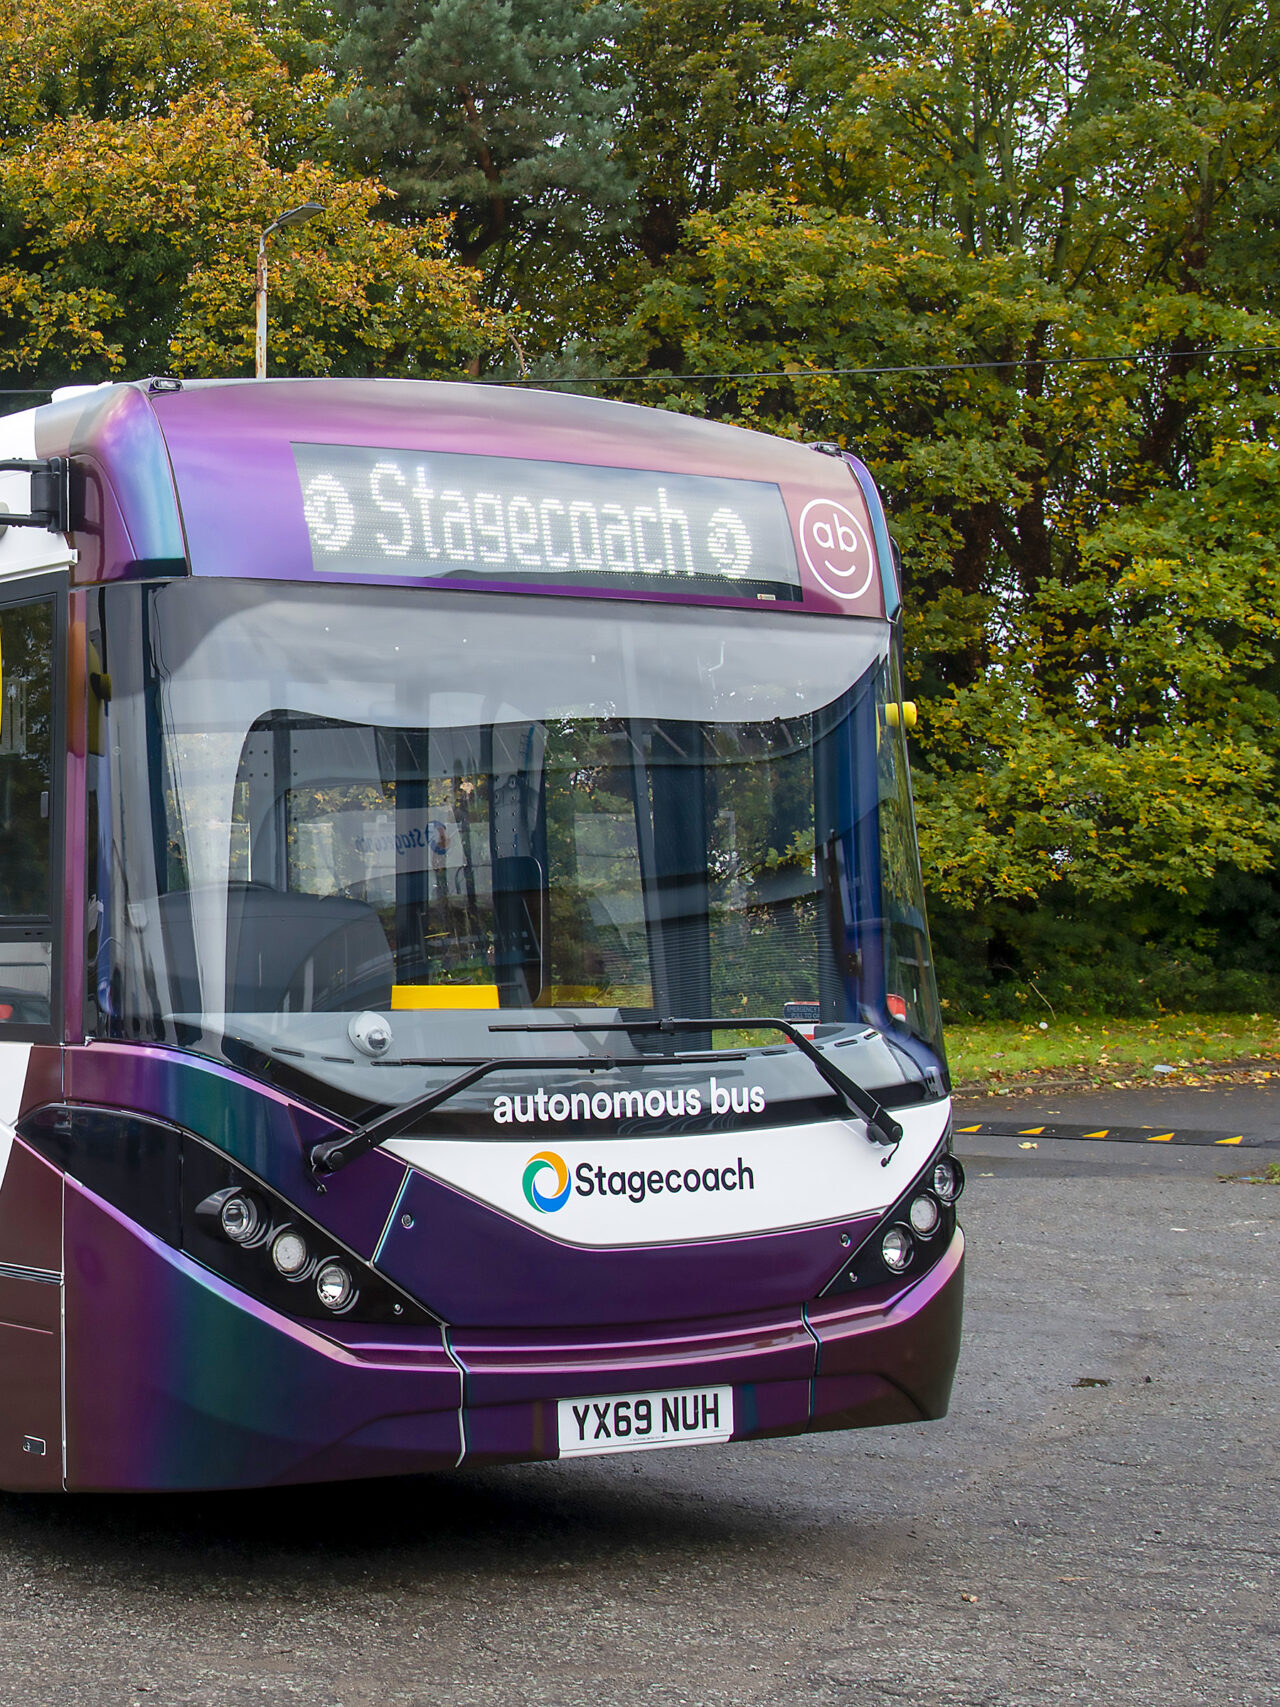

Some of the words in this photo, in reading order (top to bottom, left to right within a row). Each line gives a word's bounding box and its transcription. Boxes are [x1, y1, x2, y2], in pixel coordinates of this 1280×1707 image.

[369, 461, 695, 577] Stagecoach
[812, 509, 858, 552] ab
[493, 1087, 702, 1124] autonomous
[709, 1077, 766, 1115] bus
[575, 1157, 755, 1204] Stagecoach
[571, 1399, 652, 1441] YX69
[661, 1393, 719, 1433] NUH
